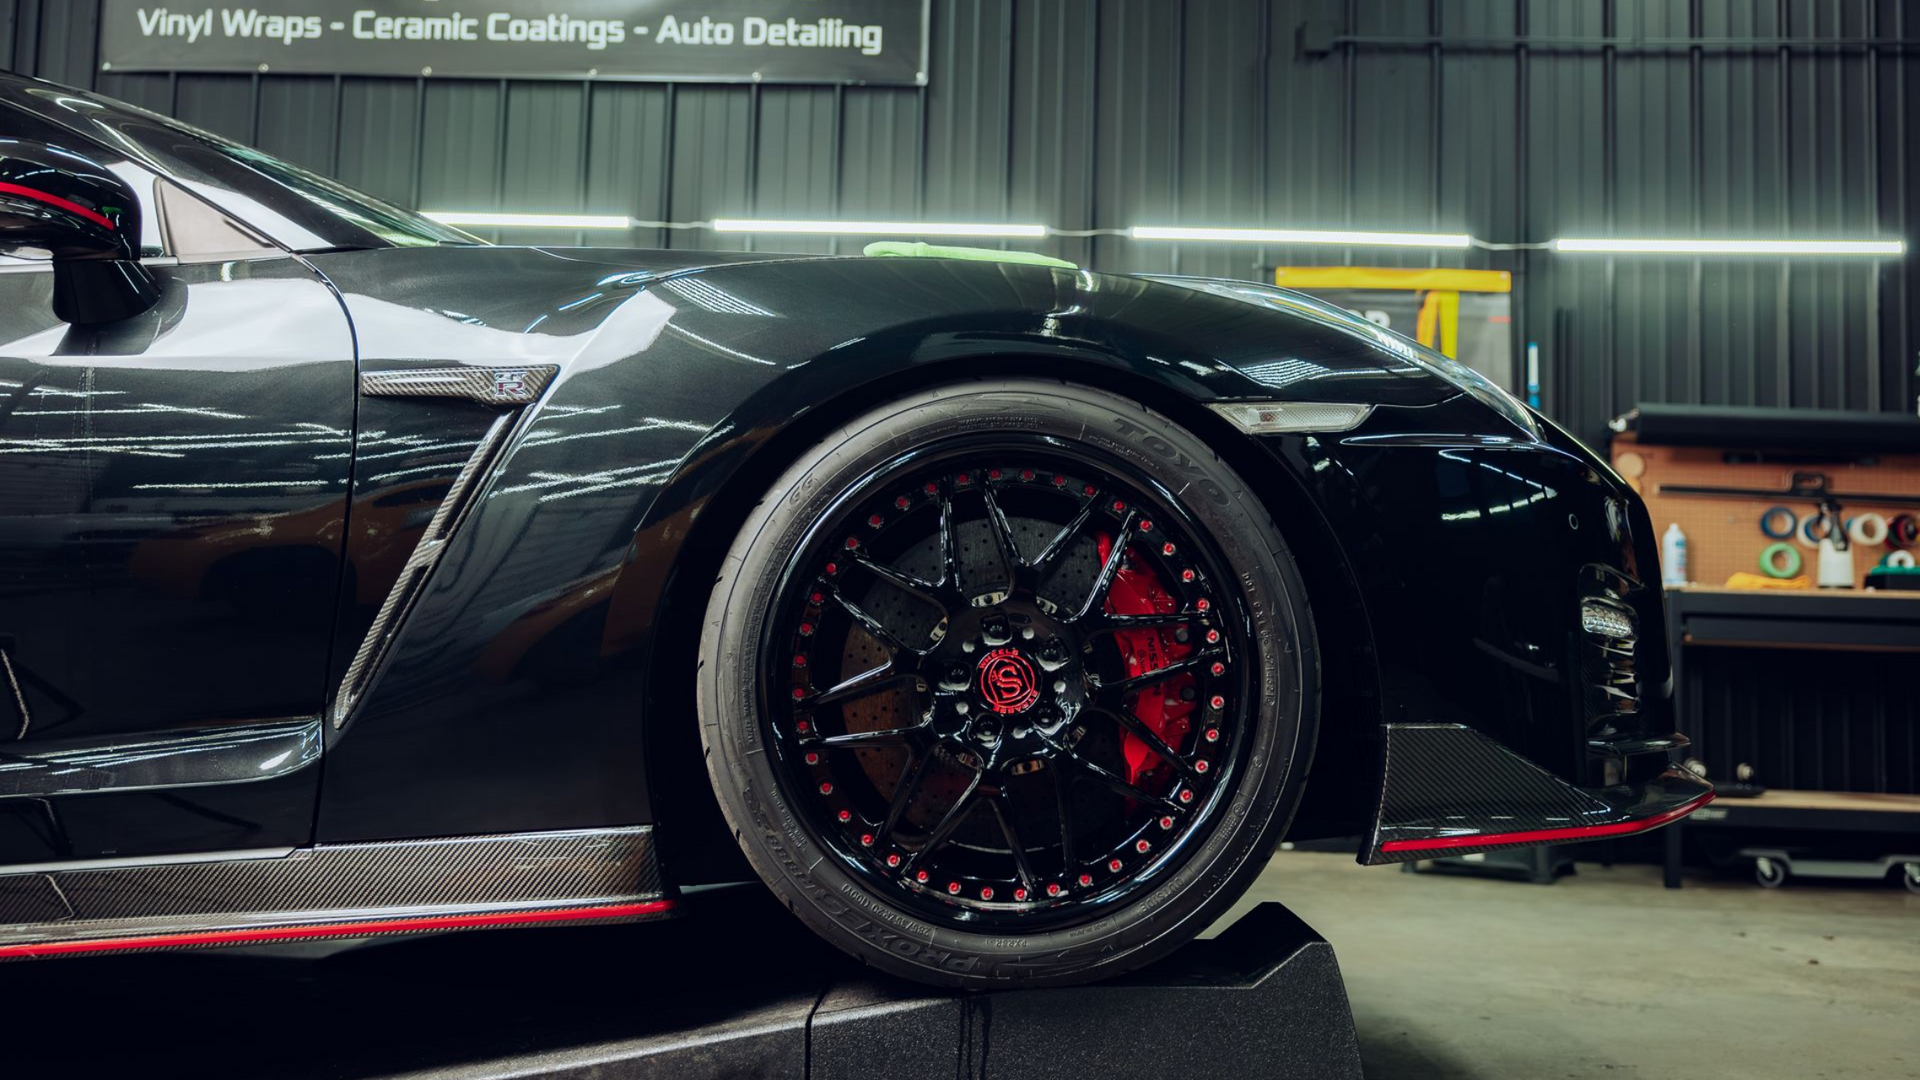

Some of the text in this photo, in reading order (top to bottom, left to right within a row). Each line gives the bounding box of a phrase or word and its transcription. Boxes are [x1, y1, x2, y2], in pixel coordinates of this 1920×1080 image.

[137, 8, 212, 43] Vinyl
[221, 9, 322, 45] Wraps
[352, 10, 479, 40] Ceramic
[486, 12, 625, 50] Coatings
[655, 15, 734, 45] Auto
[743, 17, 883, 55] Detailing
[1114, 417, 1231, 508] TOYO
[978, 647, 1019, 669] WHEELS
[1139, 876, 1184, 912] OUTSIDE
